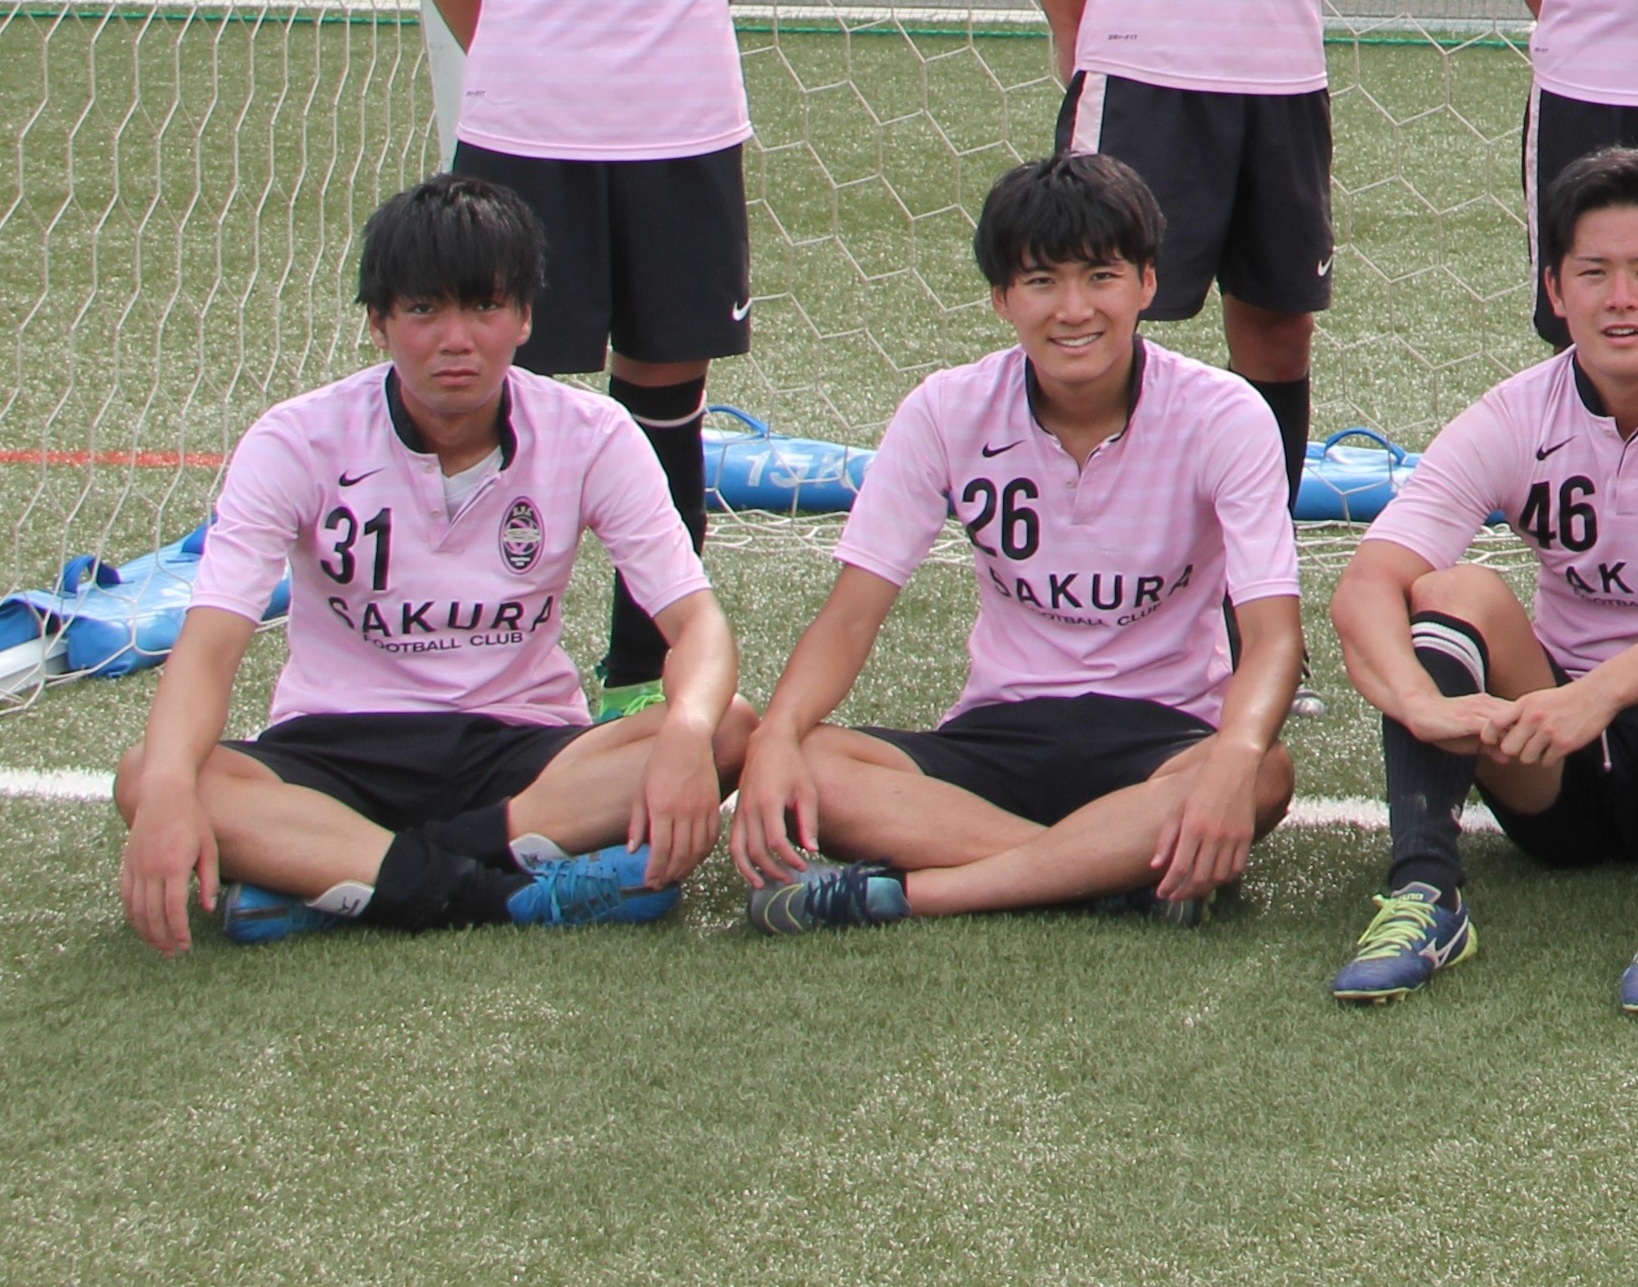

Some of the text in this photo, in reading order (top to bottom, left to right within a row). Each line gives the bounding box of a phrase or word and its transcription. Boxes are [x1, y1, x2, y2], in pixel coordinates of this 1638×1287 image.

[320, 506, 393, 591] 31
[962, 477, 1040, 561] 26
[1519, 475, 1598, 552] 46
[327, 595, 554, 638] SAKURA
[471, 631, 524, 647] CLUB
